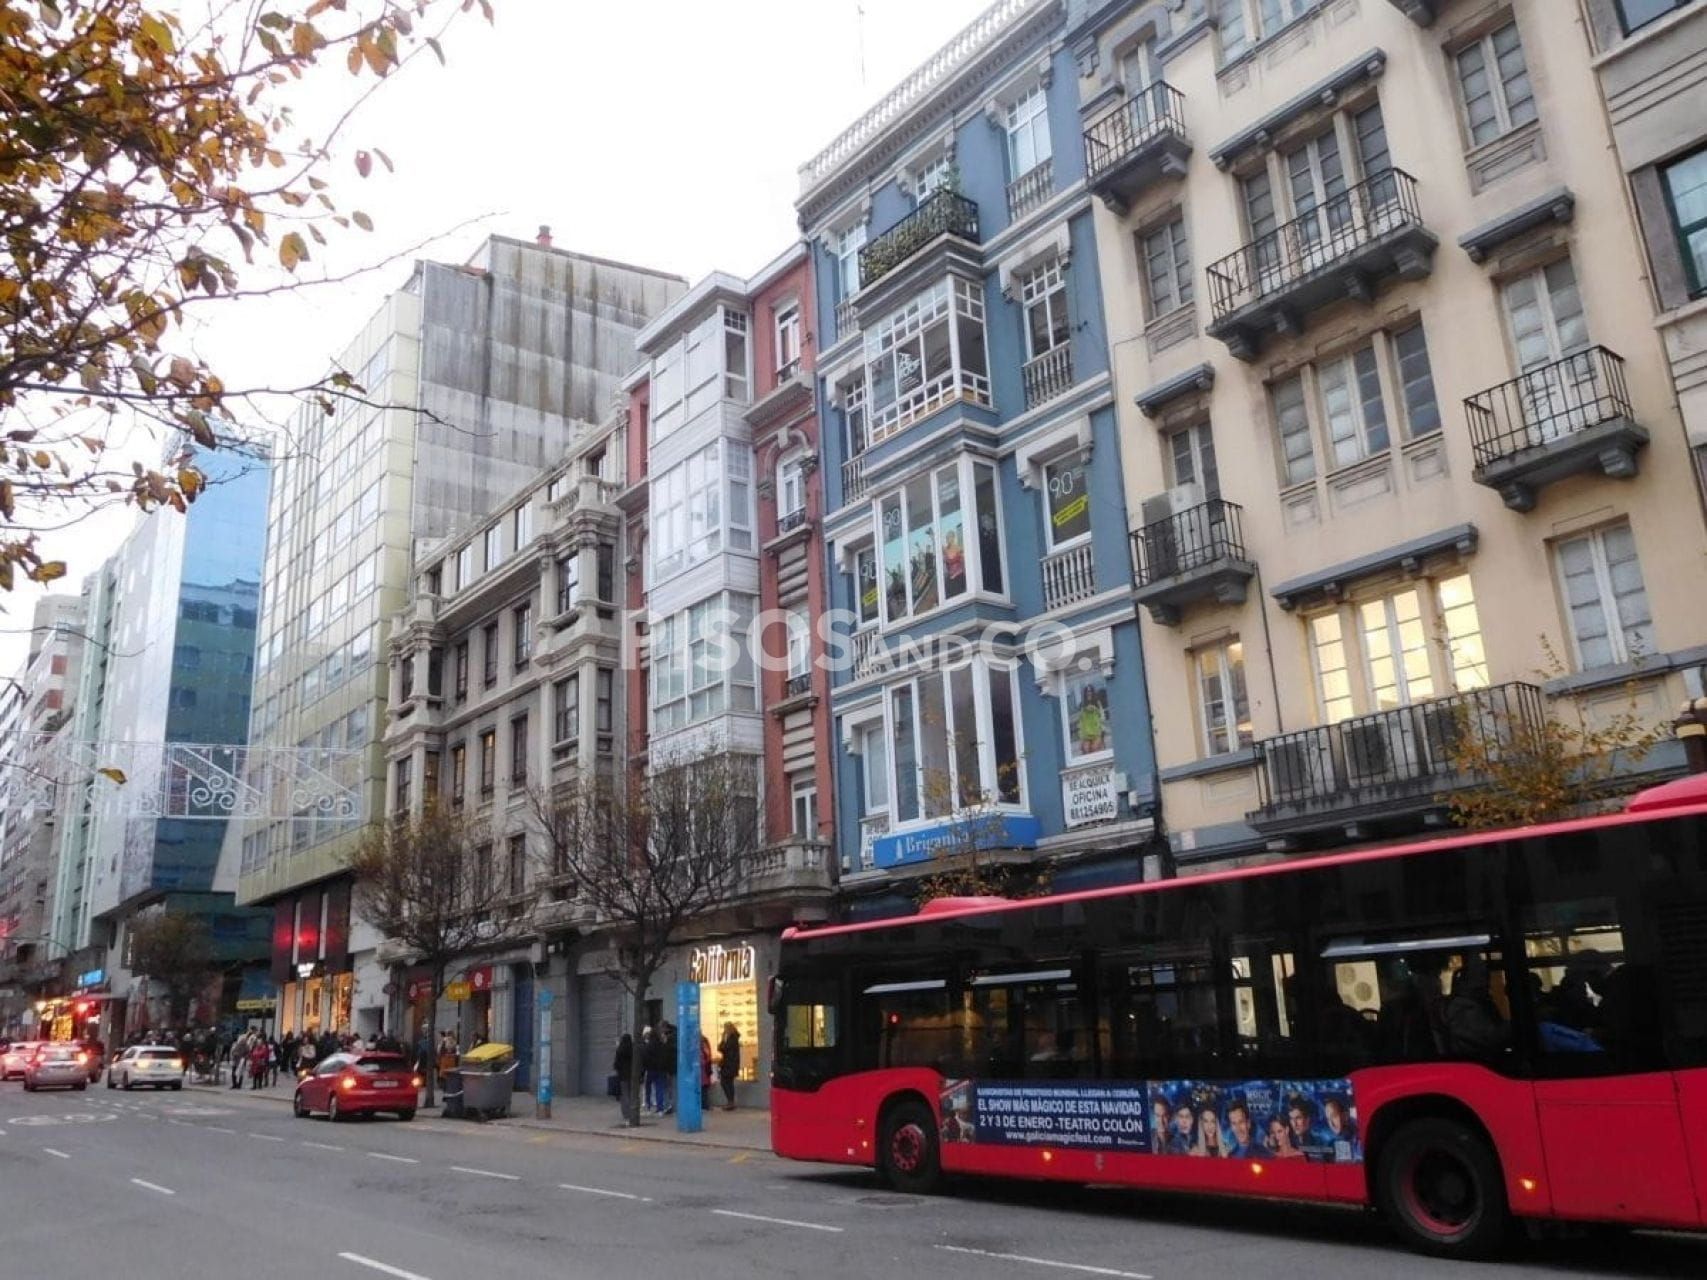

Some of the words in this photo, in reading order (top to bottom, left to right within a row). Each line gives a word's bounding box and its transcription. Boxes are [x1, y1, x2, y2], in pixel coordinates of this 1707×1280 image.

[1072, 788, 1108, 805] OFICINA
[978, 1098, 987, 1111] EL
[988, 1098, 1012, 1112] SHOW
[1012, 1096, 1030, 1112] MÁS
[1030, 1096, 1064, 1113] MÁGICO
[1065, 1100, 1077, 1113] DE
[1078, 1100, 1100, 1114] ESTA
[1101, 1101, 1142, 1116] NAVIDAD
[980, 1114, 986, 1127] 2
[987, 1114, 994, 1127] Y
[994, 1114, 1001, 1128] 3
[1002, 1115, 1017, 1128] DE
[1018, 1115, 1053, 1129] ENERO
[1102, 1115, 1143, 1134] COLÓN
